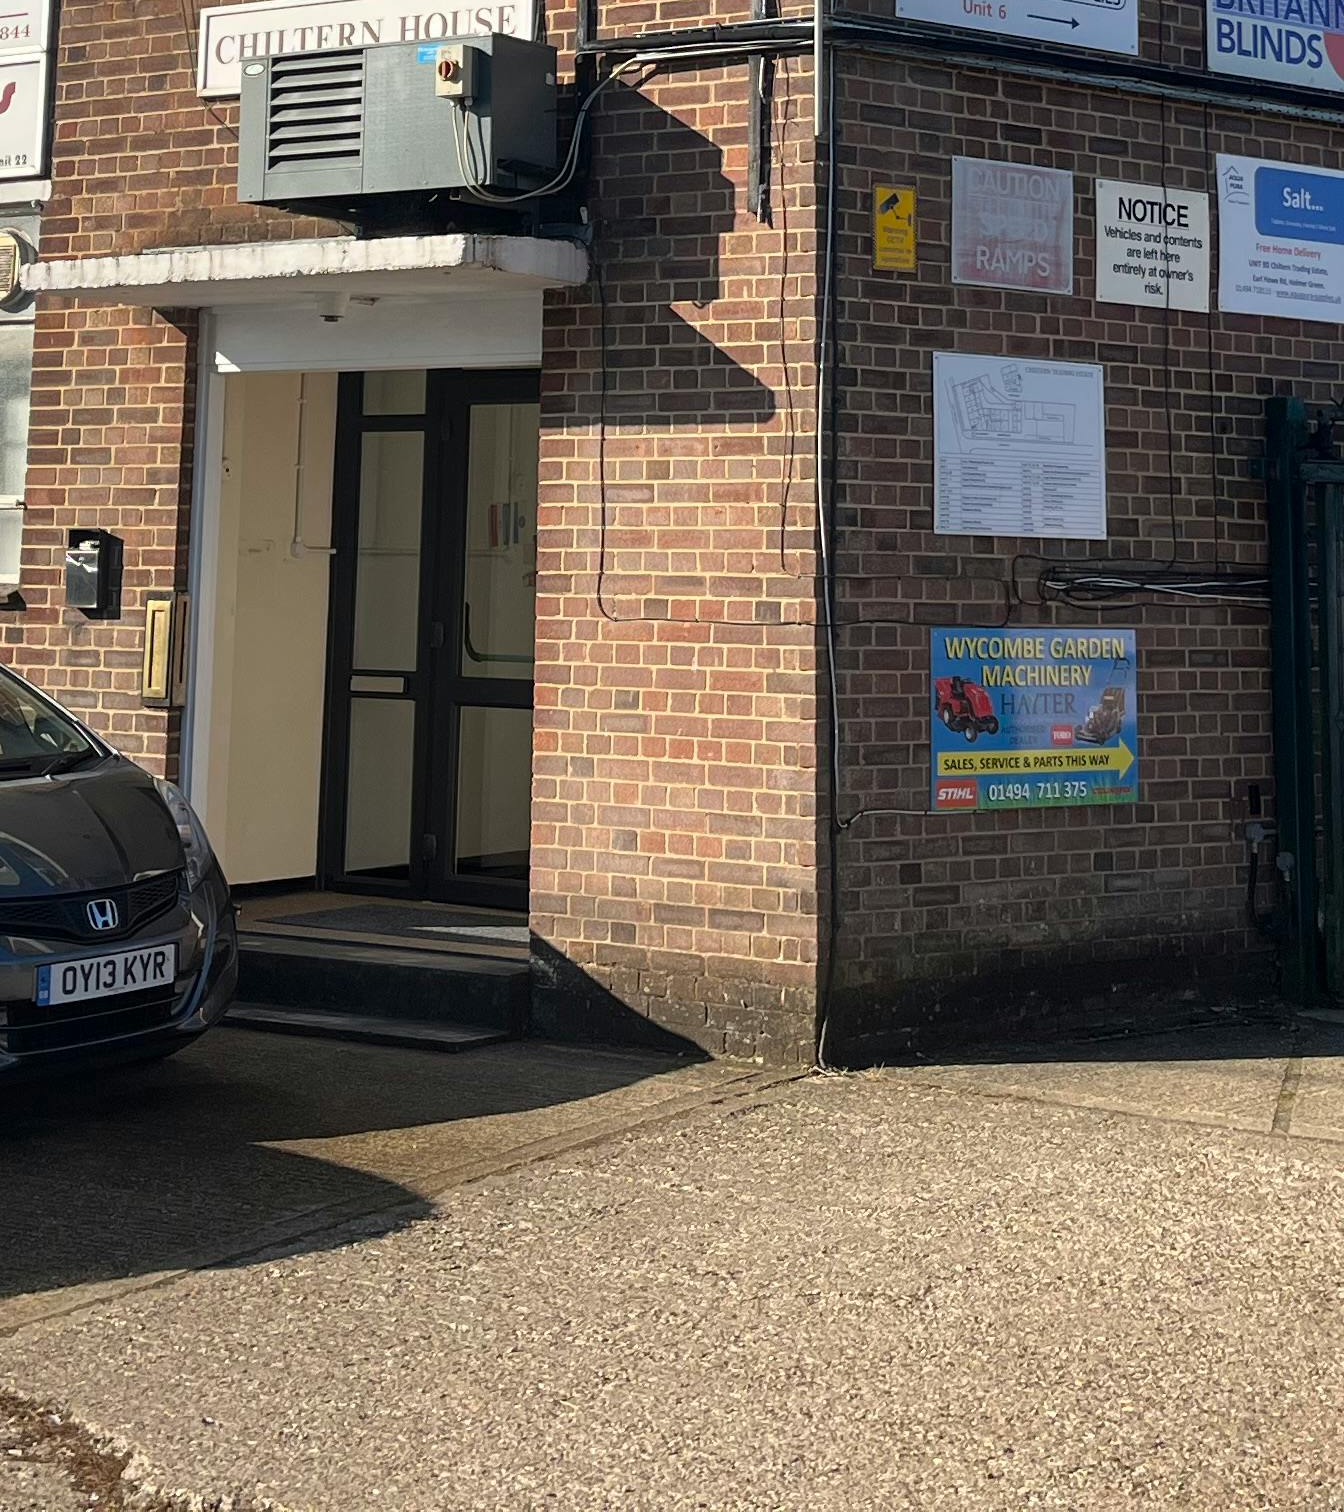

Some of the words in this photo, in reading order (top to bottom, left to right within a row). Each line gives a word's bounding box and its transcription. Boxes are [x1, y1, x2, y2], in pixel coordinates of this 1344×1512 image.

[998, 4, 1007, 19] 6
[216, 18, 384, 65] CHILTERN
[399, 5, 517, 41] HOUSE
[1216, 18, 1323, 69] BLINDS
[968, 167, 1060, 199] CAUTION
[1118, 197, 1189, 228] NOTICE
[1104, 225, 1142, 242] Vehicles
[1144, 232, 1161, 244] and
[1163, 235, 1203, 249] contents
[975, 245, 1051, 277] RAMPS
[1127, 248, 1141, 258] are
[1144, 248, 1158, 261] left
[1160, 250, 1180, 263] here
[1256, 243, 1271, 254] Free
[1273, 245, 1292, 256] Home
[1294, 247, 1321, 261] Delivery
[1112, 263, 1146, 279] entirely
[1148, 268, 1158, 278] at
[1159, 269, 1194, 281] owner's
[1144, 282, 1164, 295] risk.
[944, 637, 1045, 660] WYCOMBE
[1050, 637, 1125, 660] GARDEN
[982, 665, 1092, 687] MACHINERY
[1001, 693, 1077, 715] HAYTER
[944, 757, 978, 771] SALES,
[980, 756, 1020, 769] SERVICE
[1023, 756, 1031, 768] &
[1034, 755, 1064, 768] PARTS
[1066, 755, 1086, 767] THIS
[1088, 754, 1110, 766] WAY
[937, 787, 974, 800] STIHL
[989, 783, 1030, 801] 01494
[1037, 782, 1061, 799] 711
[1063, 781, 1087, 798] 375
[62, 959, 116, 995] OY13
[124, 951, 166, 986] KYR
